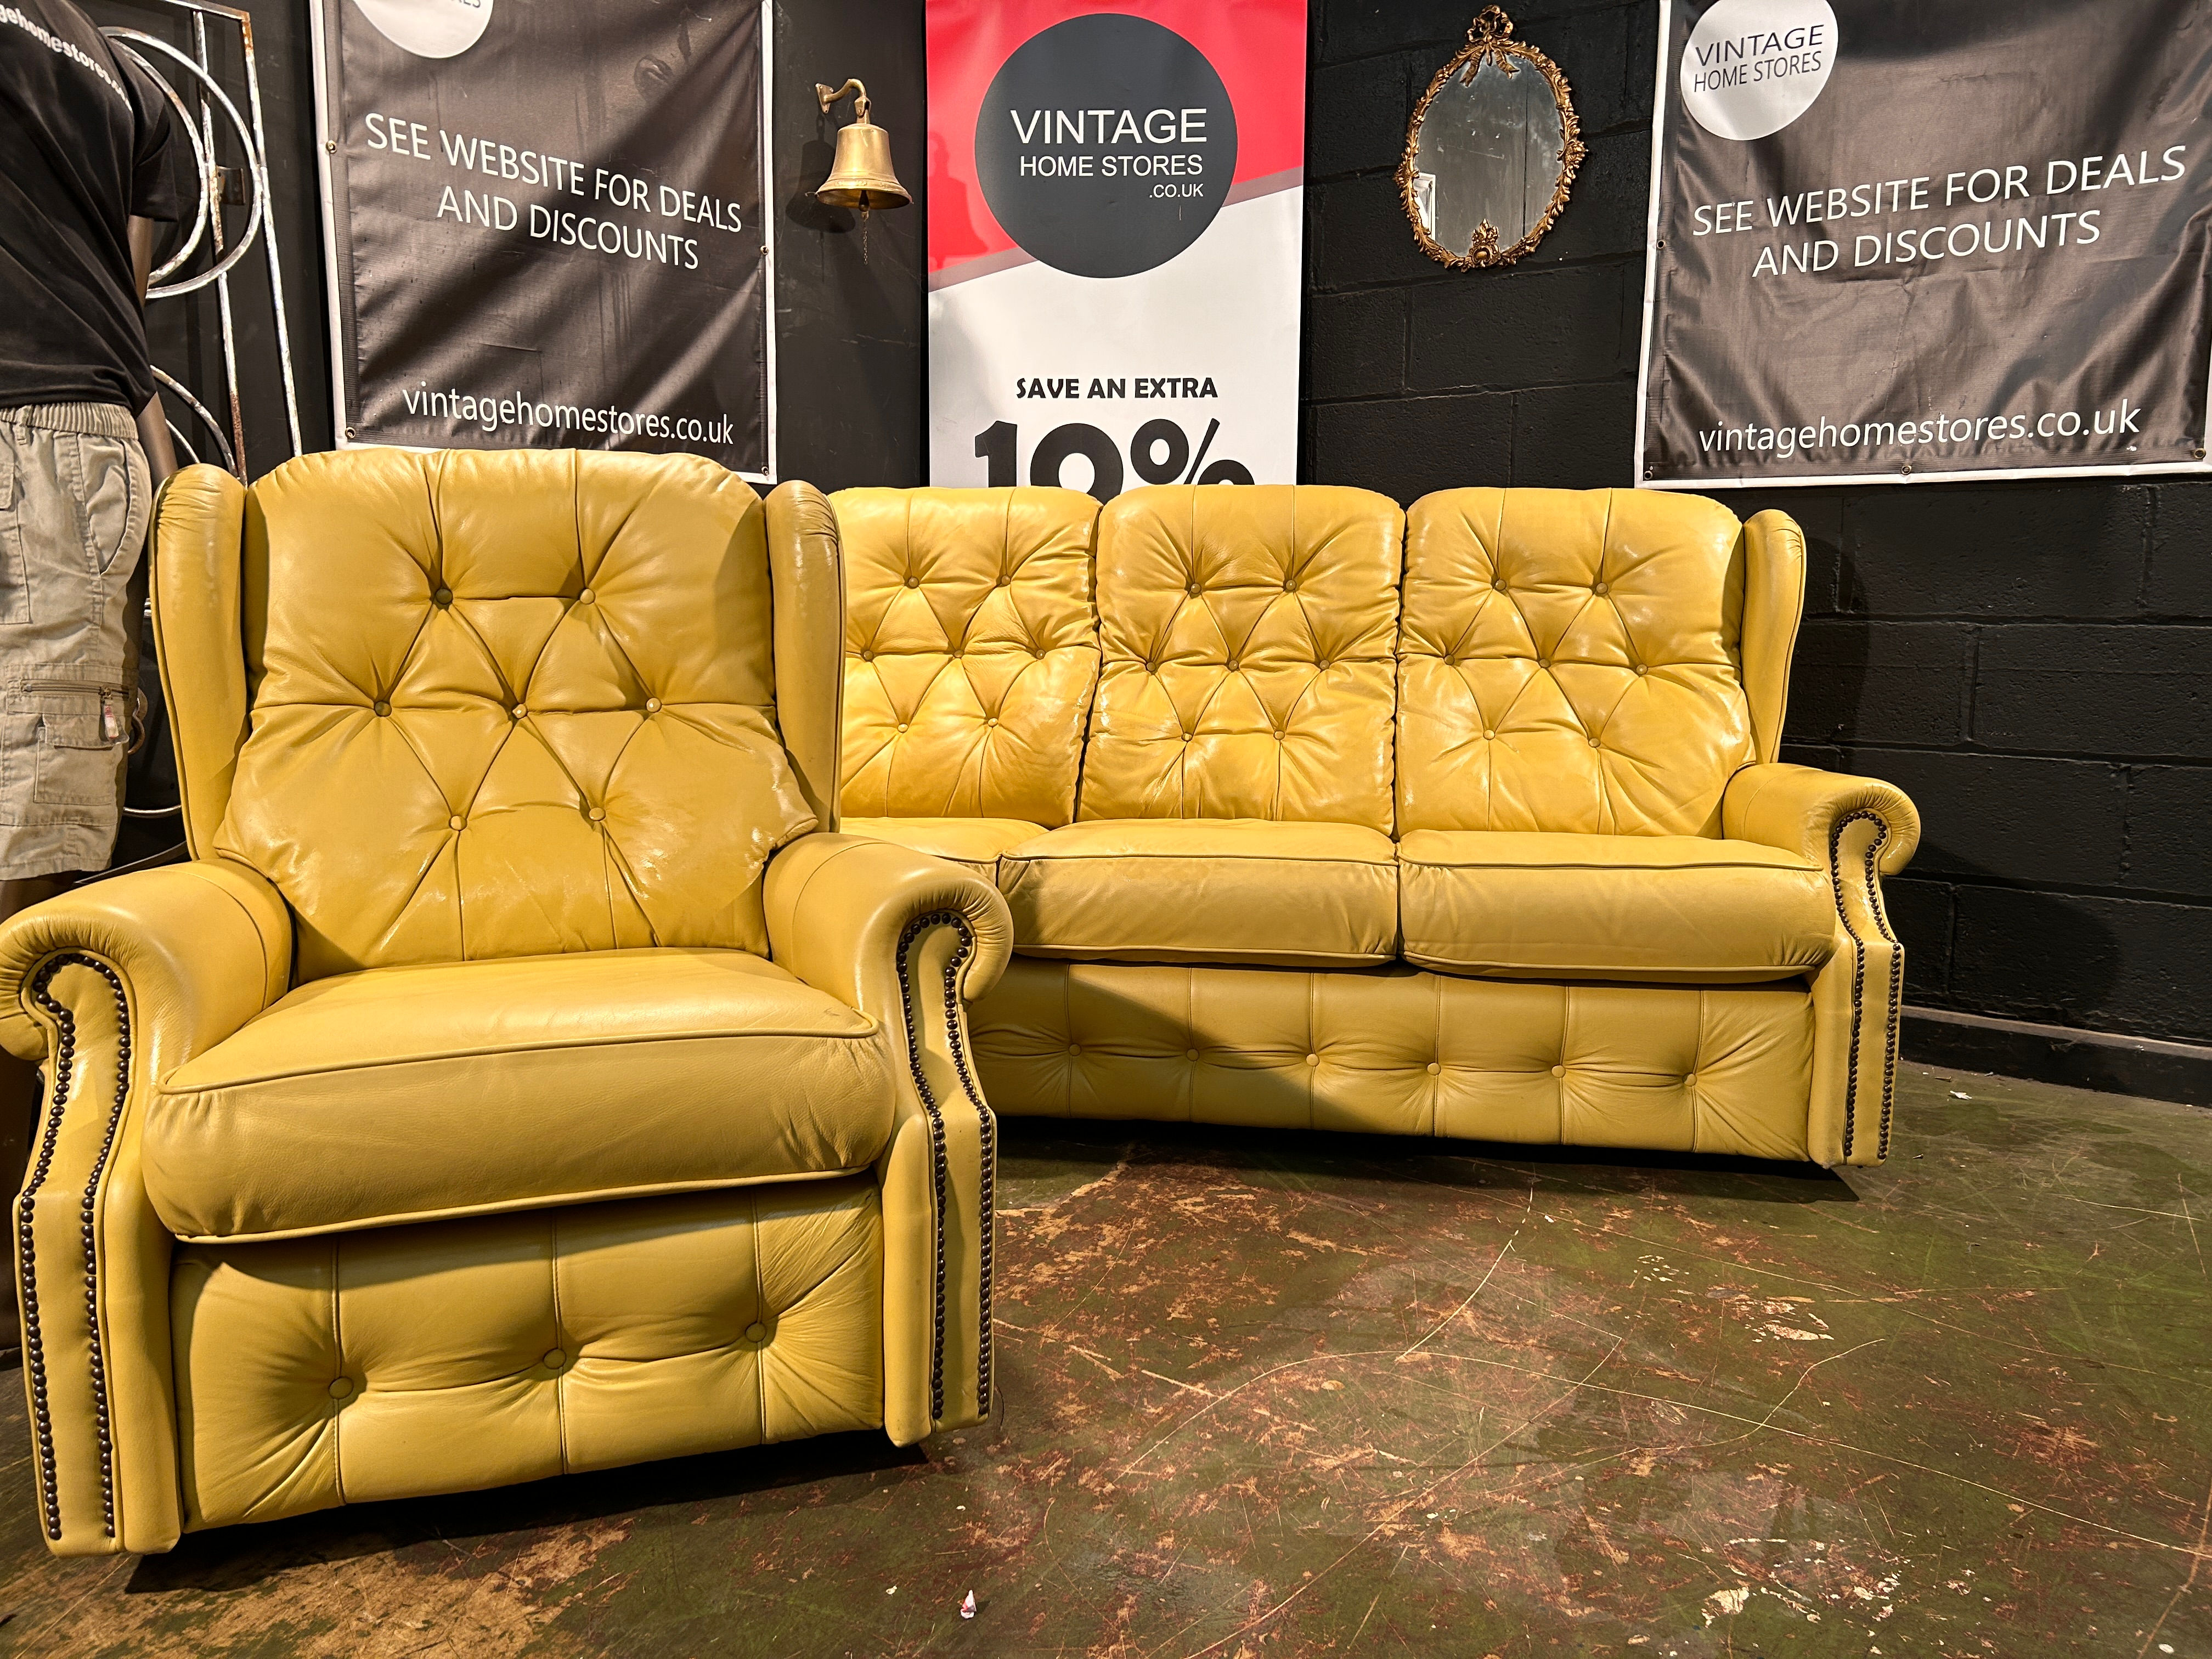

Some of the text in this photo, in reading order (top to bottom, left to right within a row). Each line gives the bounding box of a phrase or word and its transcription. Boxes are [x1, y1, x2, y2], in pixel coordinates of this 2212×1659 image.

[1694, 50, 1822, 93] HOME STORES
[1695, 24, 1825, 66] VINTAGE
[1010, 108, 1207, 144] VINTAGE
[365, 112, 742, 233] SEE WEBSITE FOR DEALS
[1020, 154, 1203, 177] HOME STORES
[1149, 183, 1204, 198] .CO.UK
[1692, 145, 2186, 236] SEE WEBSITE FOR DEALS
[437, 185, 699, 269] AND DISCOUNTS
[1752, 210, 2100, 278] AND DISCOUNTS
[402, 381, 734, 445] vintagehomestores.co.uk
[1016, 377, 1218, 399] SAVE AN EXTRA
[1699, 398, 2141, 459] vintagehomestores.co.uk
[974, 418, 1255, 503] 10%
